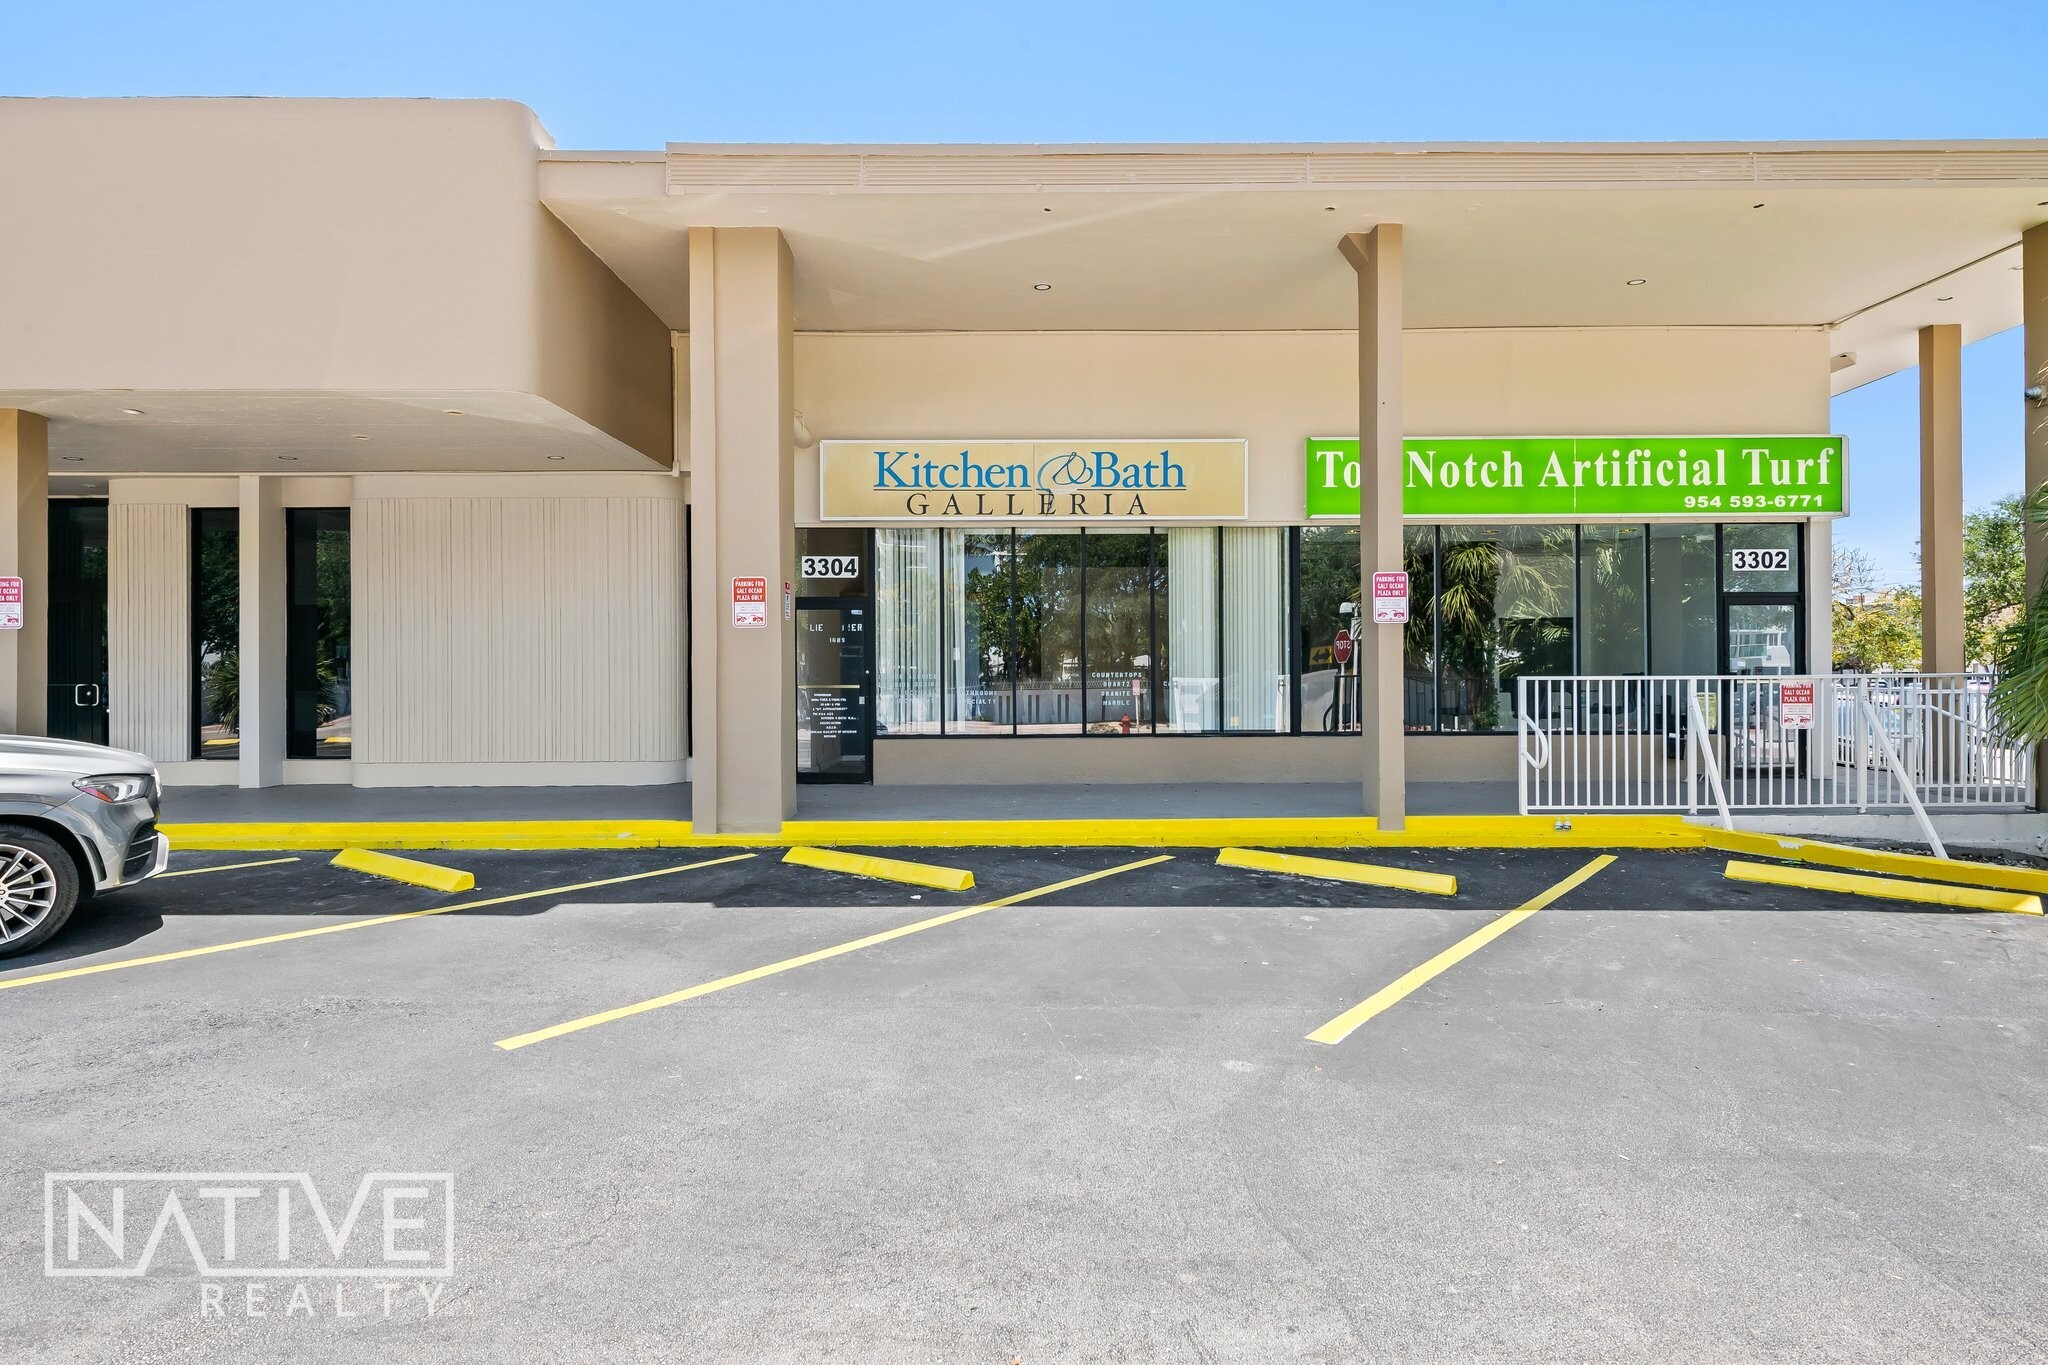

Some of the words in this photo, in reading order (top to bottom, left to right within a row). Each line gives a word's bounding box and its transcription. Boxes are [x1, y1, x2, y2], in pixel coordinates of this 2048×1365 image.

[873, 450, 1031, 488] Kitchen
[1091, 450, 1186, 488] Bath
[1316, 450, 1361, 489] To
[1406, 450, 1524, 488] Notch
[1538, 449, 1727, 488] Artificial
[1742, 447, 1835, 486] Turf
[906, 493, 1148, 515] GALLERIA
[1684, 495, 1722, 508] 954
[1730, 494, 1823, 508] 593-6771
[804, 558, 857, 576] 3304
[1734, 551, 1787, 569] 3302
